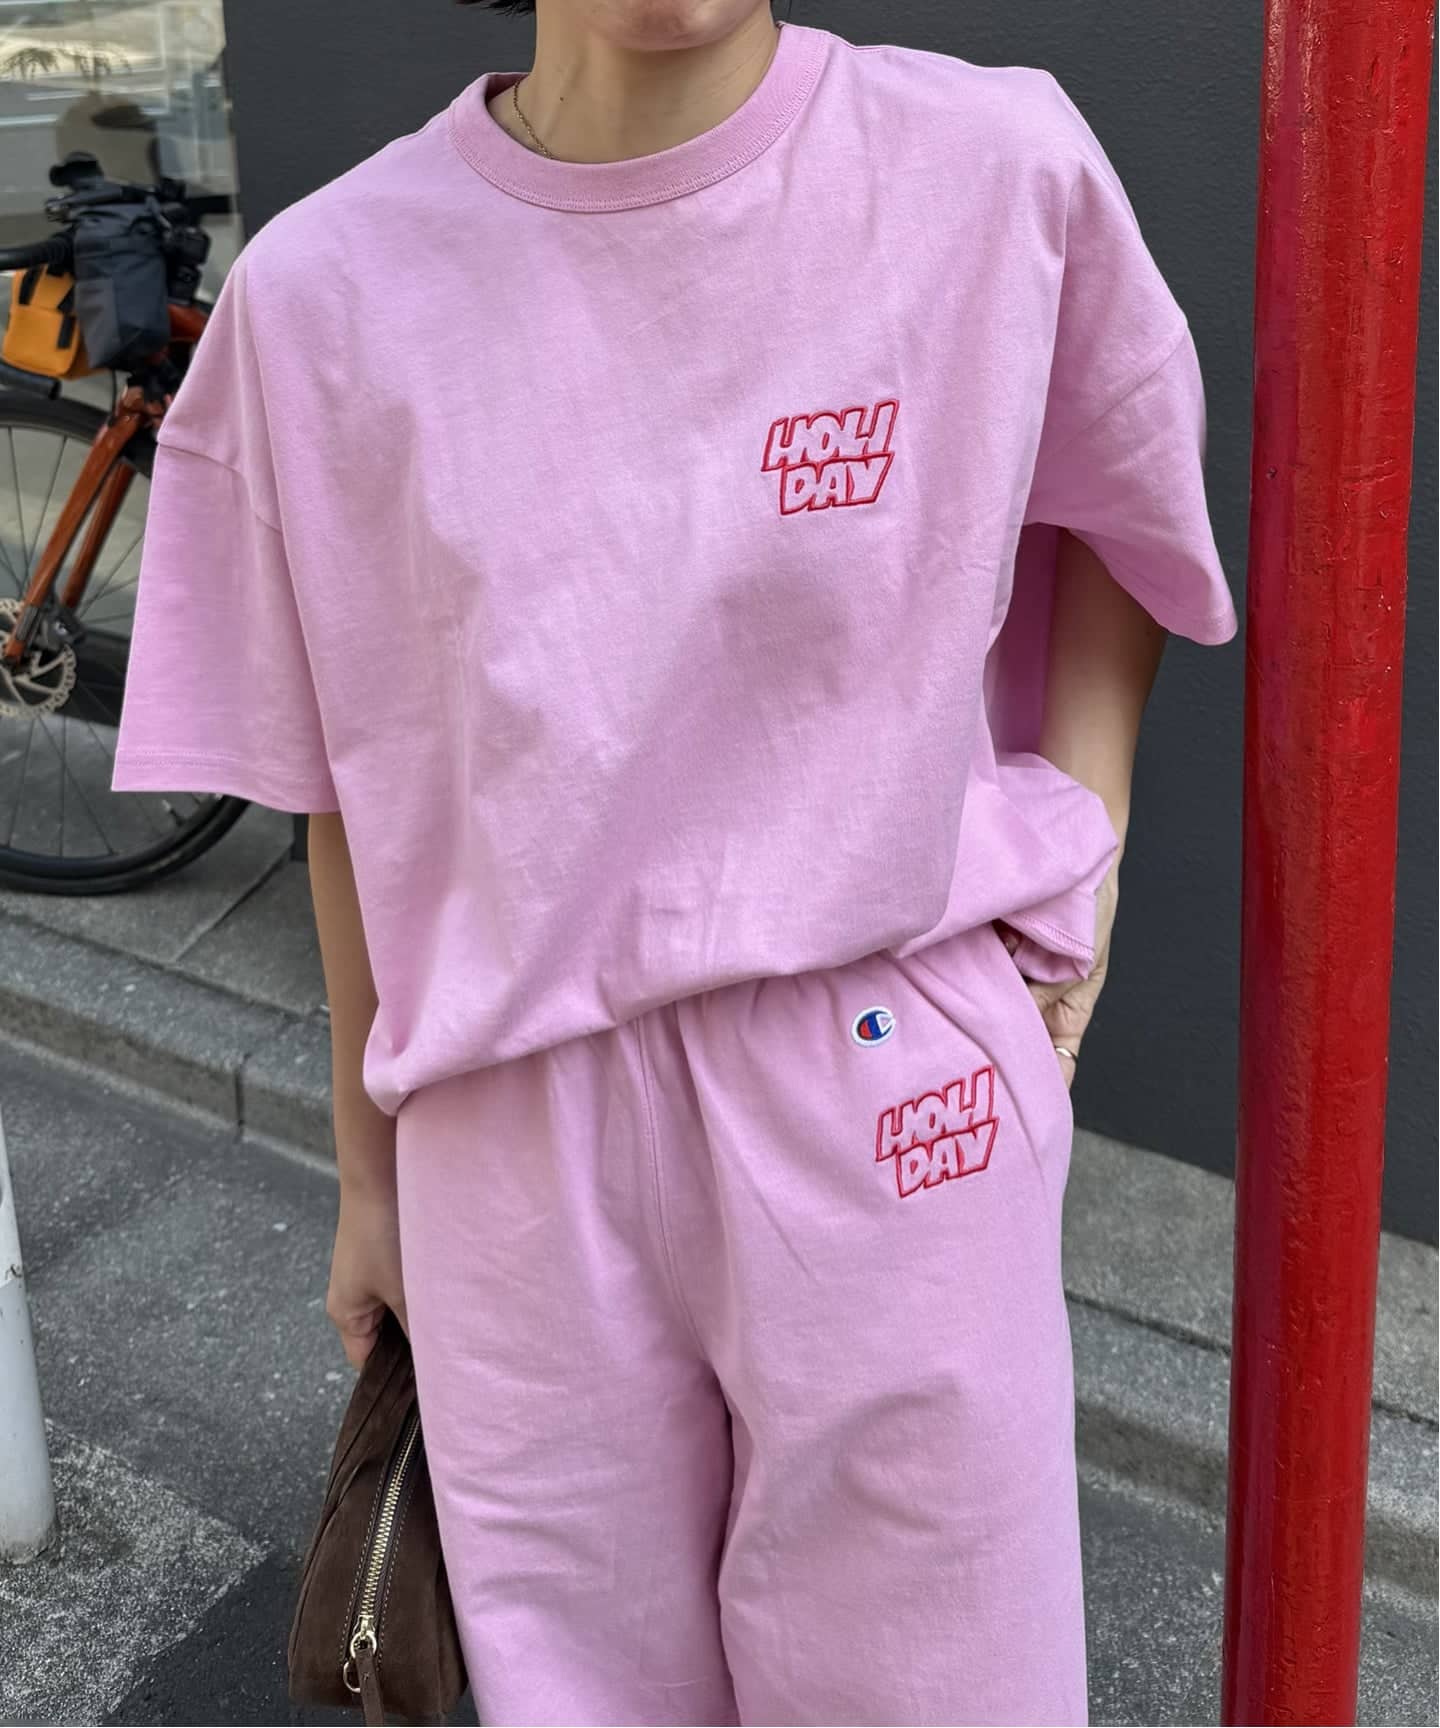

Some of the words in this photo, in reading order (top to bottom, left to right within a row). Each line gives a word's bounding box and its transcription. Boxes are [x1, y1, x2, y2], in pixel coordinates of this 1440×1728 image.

[761, 398, 899, 472] HOLI
[780, 451, 895, 515] DAY
[876, 1064, 994, 1162] HOLI
[896, 1117, 999, 1199] DAY
